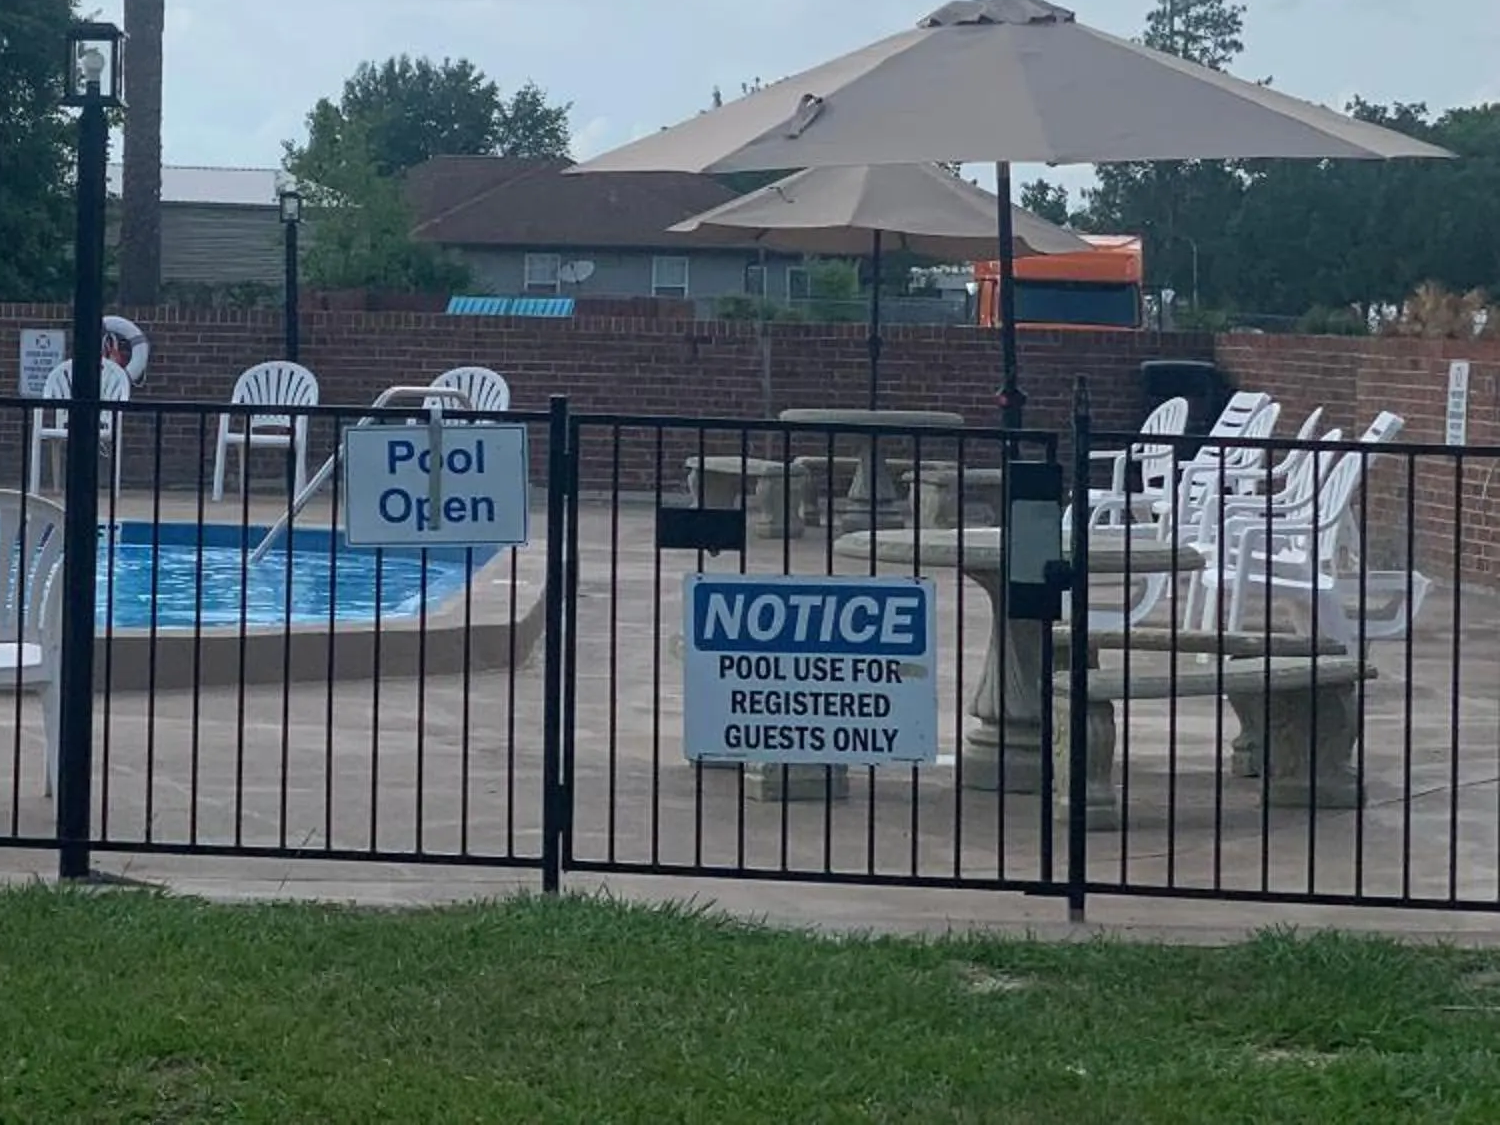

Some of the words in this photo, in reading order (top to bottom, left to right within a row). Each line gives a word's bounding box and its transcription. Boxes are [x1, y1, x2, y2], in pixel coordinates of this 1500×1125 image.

[387, 439, 485, 475] Pool
[378, 488, 495, 532] Open
[703, 592, 920, 644] NOTICE
[719, 655, 787, 680] POOL
[794, 657, 845, 682] USE
[852, 658, 903, 684] FOR
[731, 691, 891, 718] REGISTERED
[724, 724, 826, 751] GUESTS
[833, 727, 899, 753] ONLY
